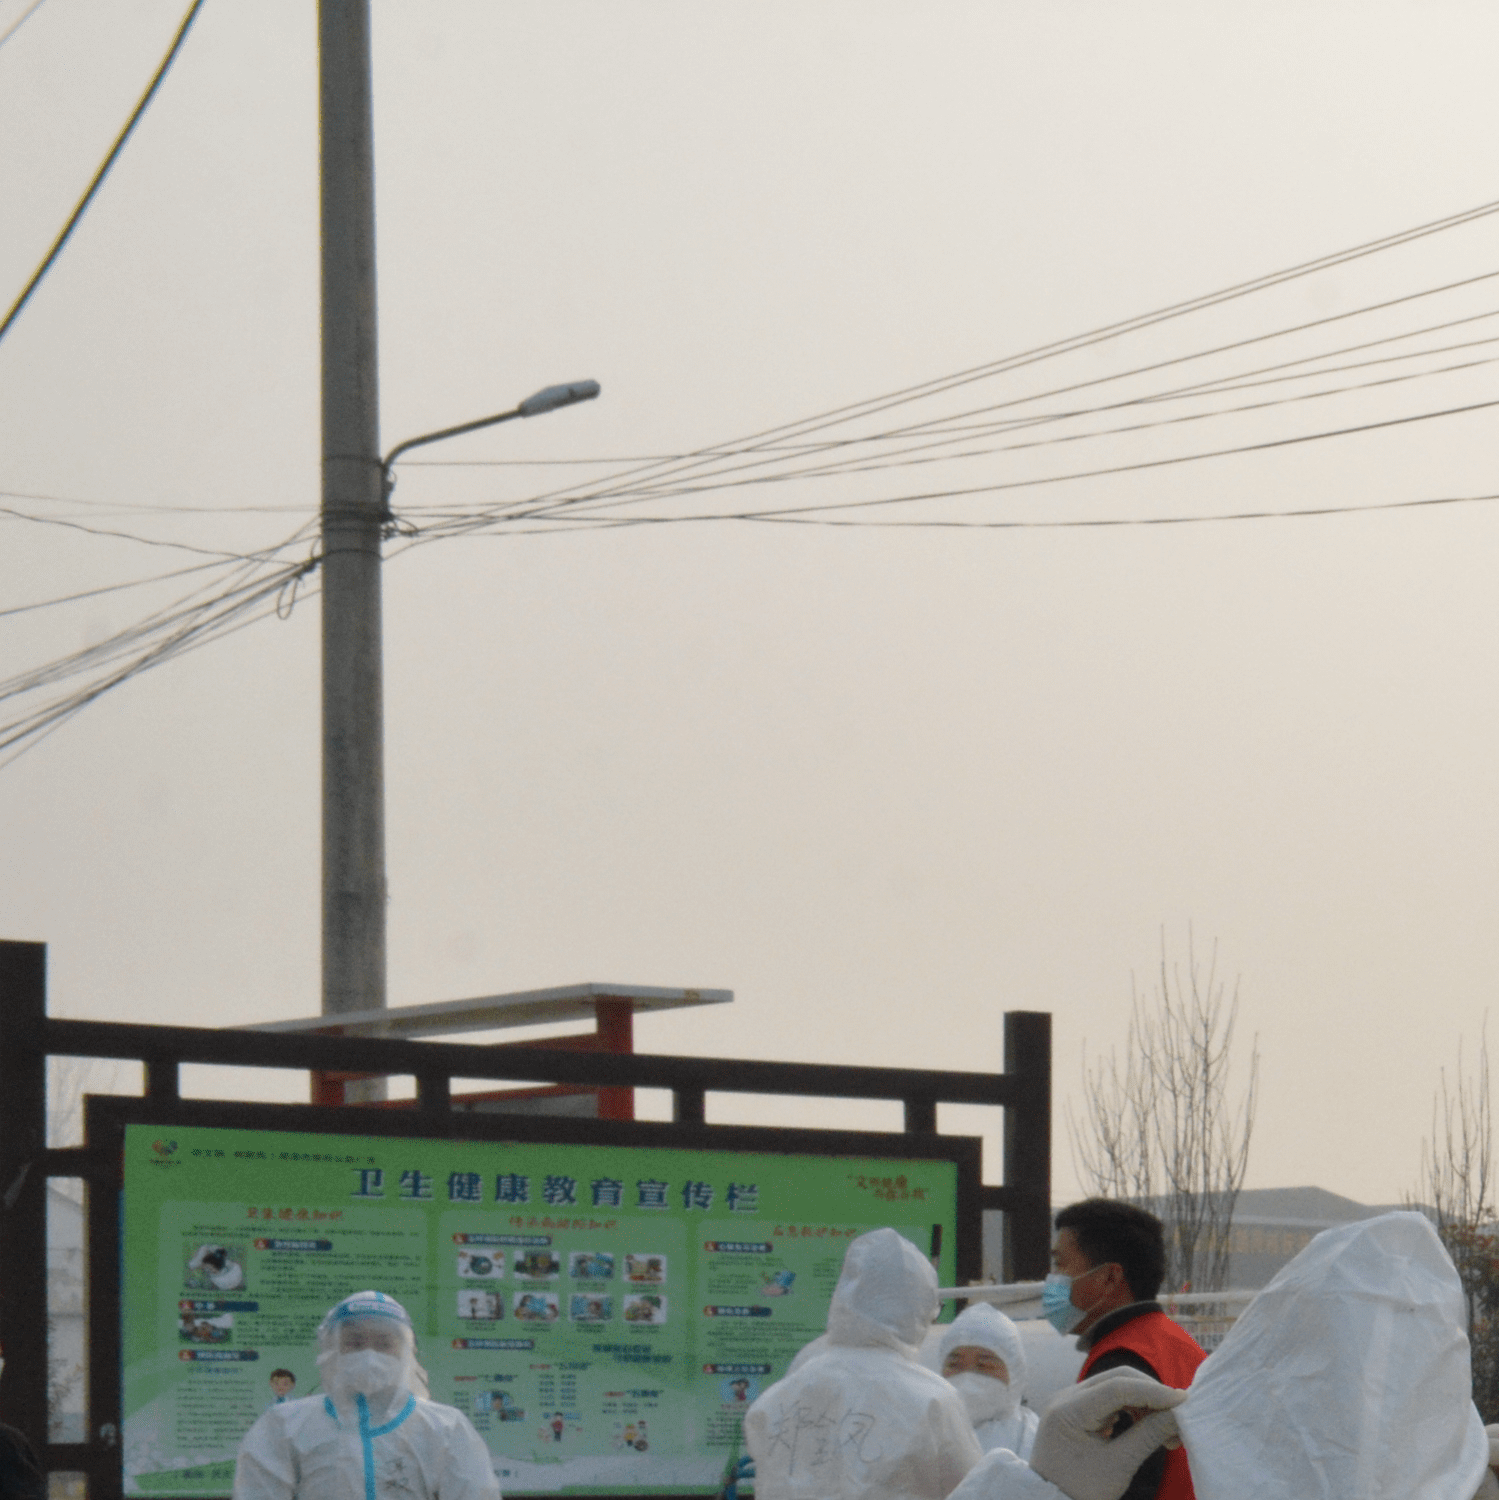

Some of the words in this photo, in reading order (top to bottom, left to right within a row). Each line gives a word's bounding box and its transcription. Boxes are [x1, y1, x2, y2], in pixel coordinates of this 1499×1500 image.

[351, 1168, 759, 1213] 卫生健康教育宣传栏
